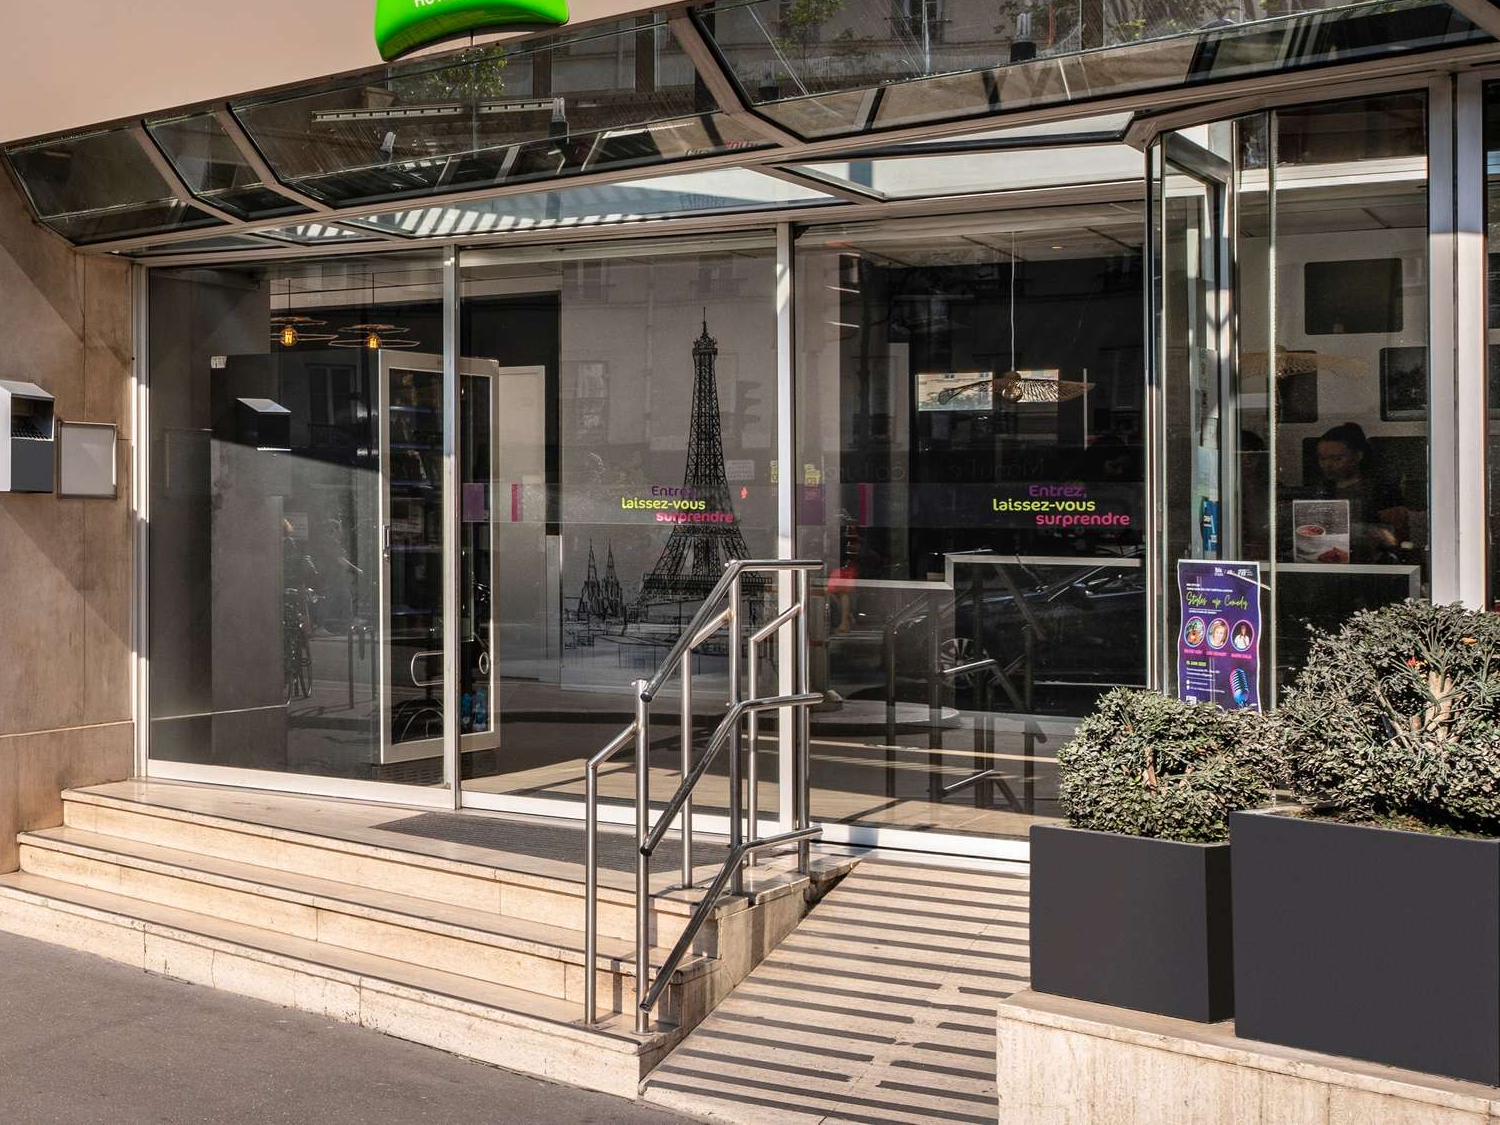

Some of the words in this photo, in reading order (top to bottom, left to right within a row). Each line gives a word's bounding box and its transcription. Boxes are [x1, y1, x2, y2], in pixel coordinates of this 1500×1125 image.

[1028, 484, 1087, 498] Entrez,
[621, 497, 706, 510] laissez-vous
[992, 498, 1096, 511] laissez-vous
[656, 511, 734, 524] surprendre
[1035, 512, 1131, 527] surprendre
